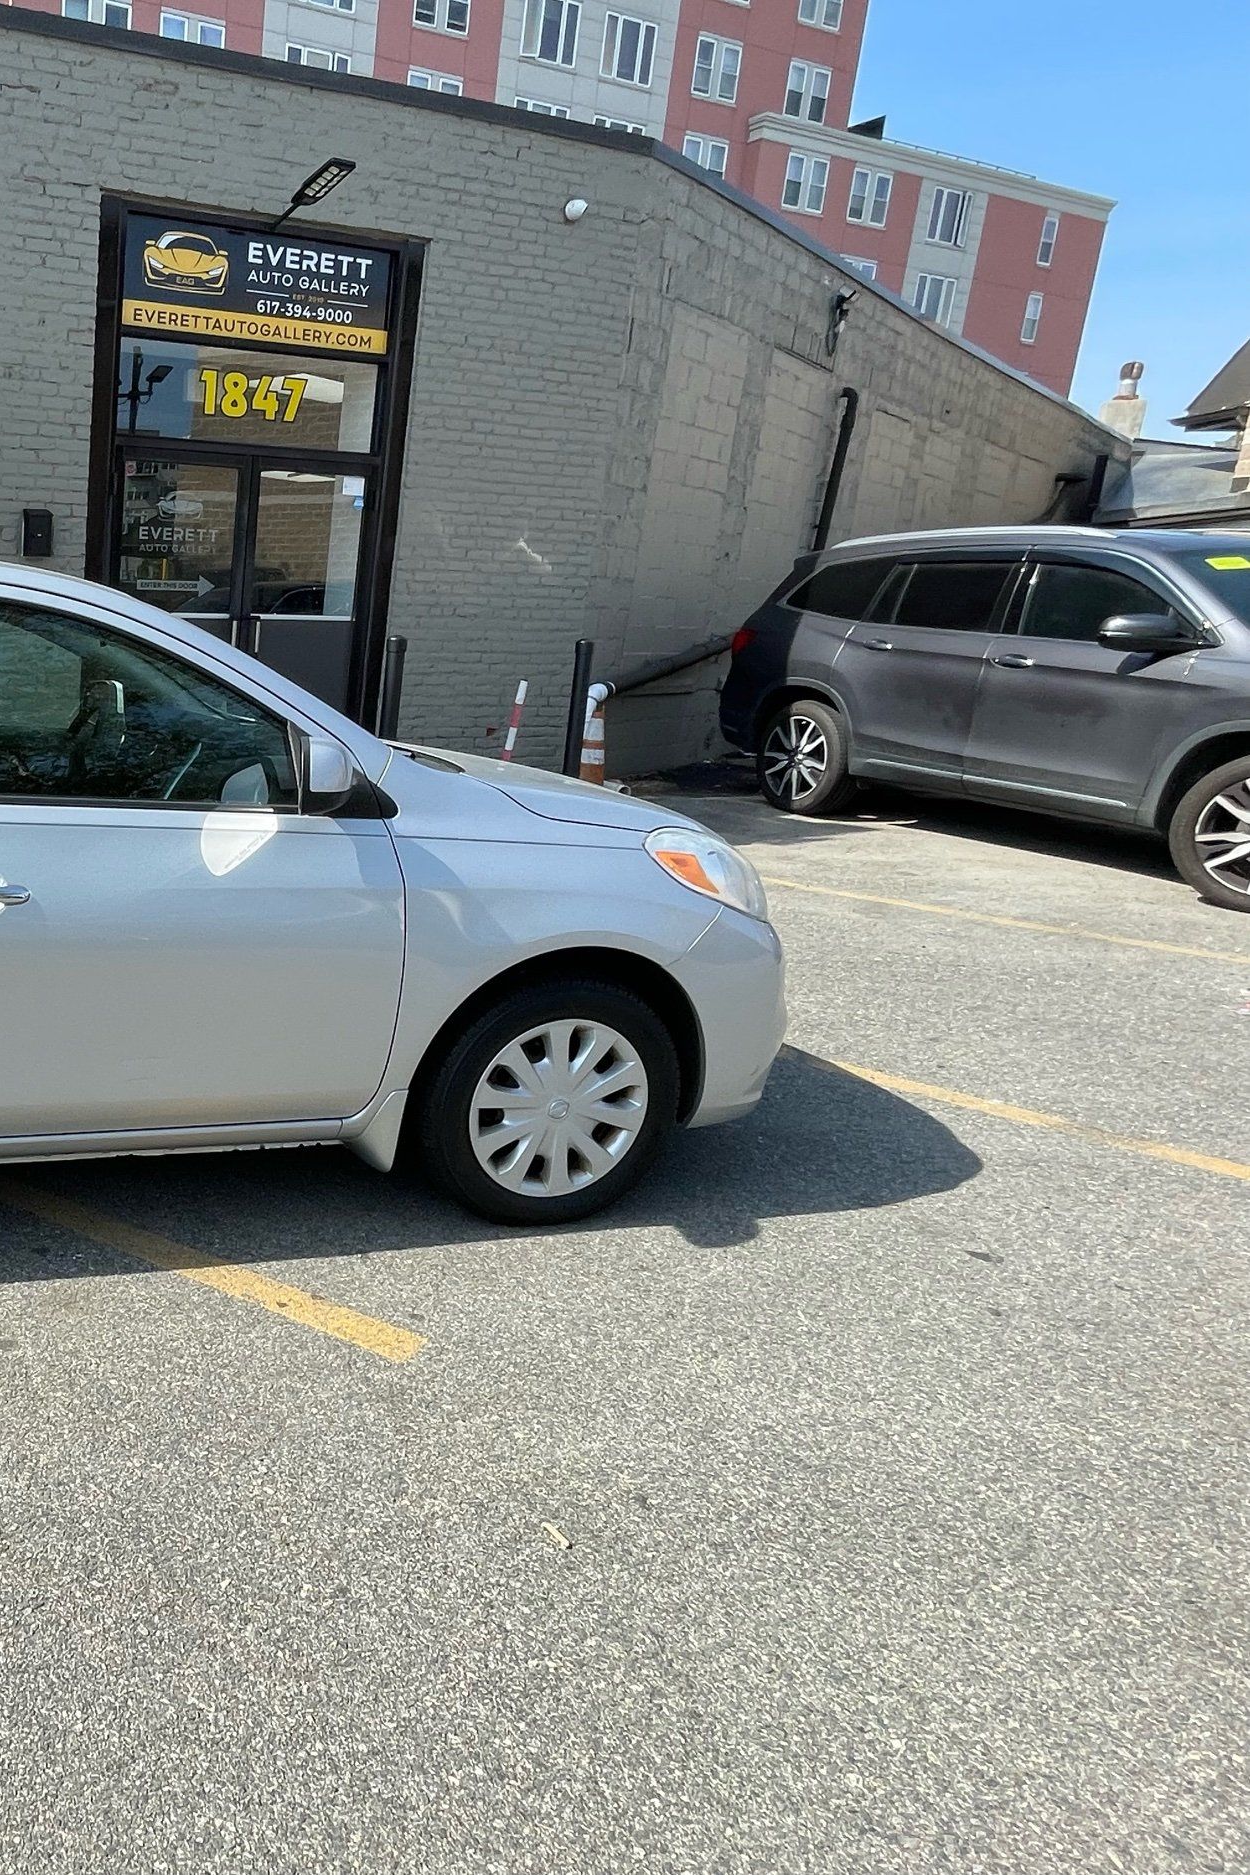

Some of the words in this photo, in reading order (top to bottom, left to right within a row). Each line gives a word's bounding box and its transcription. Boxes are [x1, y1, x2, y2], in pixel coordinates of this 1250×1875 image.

[248, 241, 373, 279] EVERETT
[247, 269, 293, 287] AUTO
[299, 276, 370, 297] GALLERY
[257, 300, 353, 324] 617-394-9000
[133, 308, 372, 349] EVERETTAUTOGALLERY.COM
[200, 368, 309, 423] 1847
[138, 526, 219, 542] EVERETT
[138, 543, 169, 553] AUTO
[172, 544, 217, 554] GALLERY
